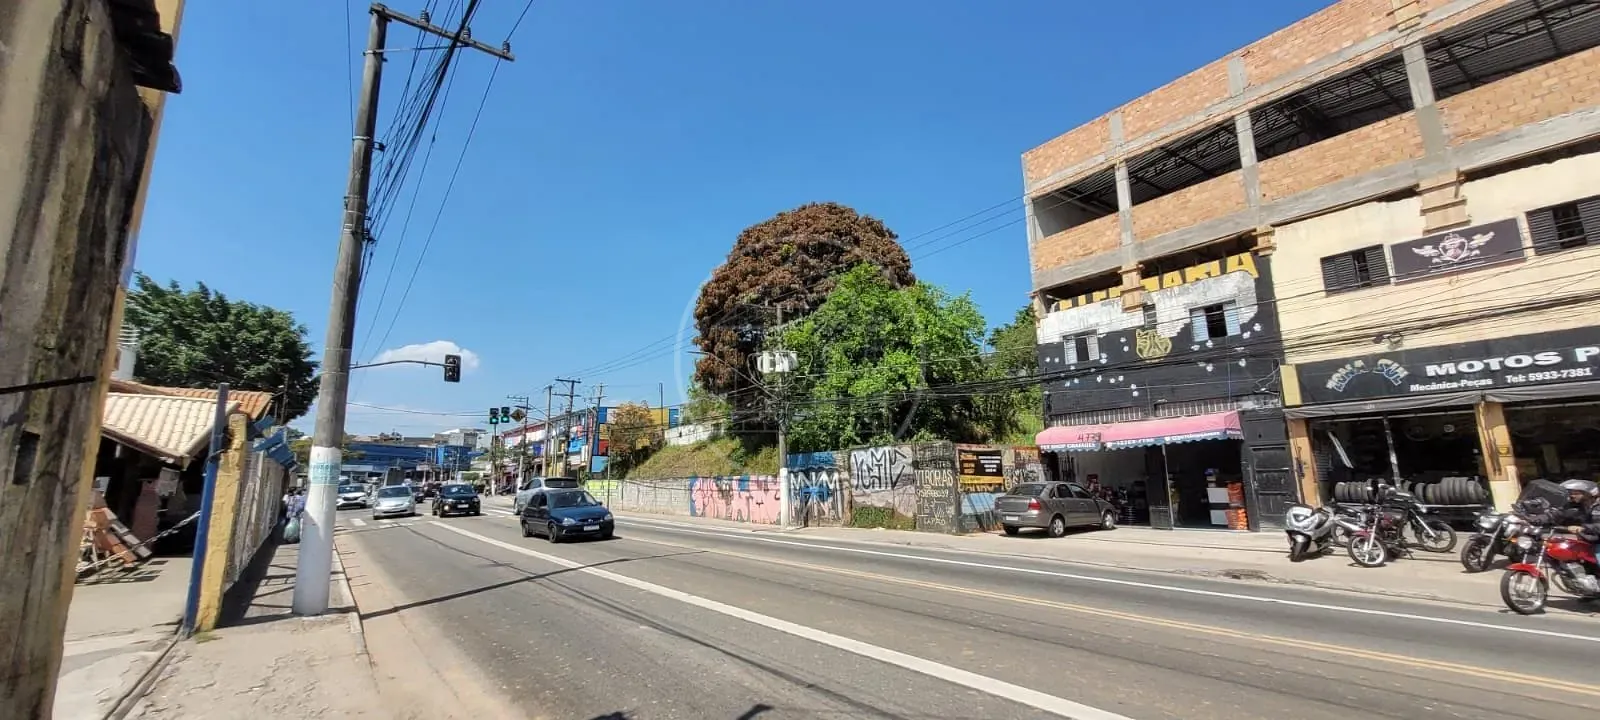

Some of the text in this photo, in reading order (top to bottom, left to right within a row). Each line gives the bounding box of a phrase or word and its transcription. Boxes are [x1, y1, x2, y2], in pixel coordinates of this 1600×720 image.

[1425, 351, 1563, 377] MOTOS
[1410, 366, 1593, 393] Mecânica-Peças Tel: 5933-7381
